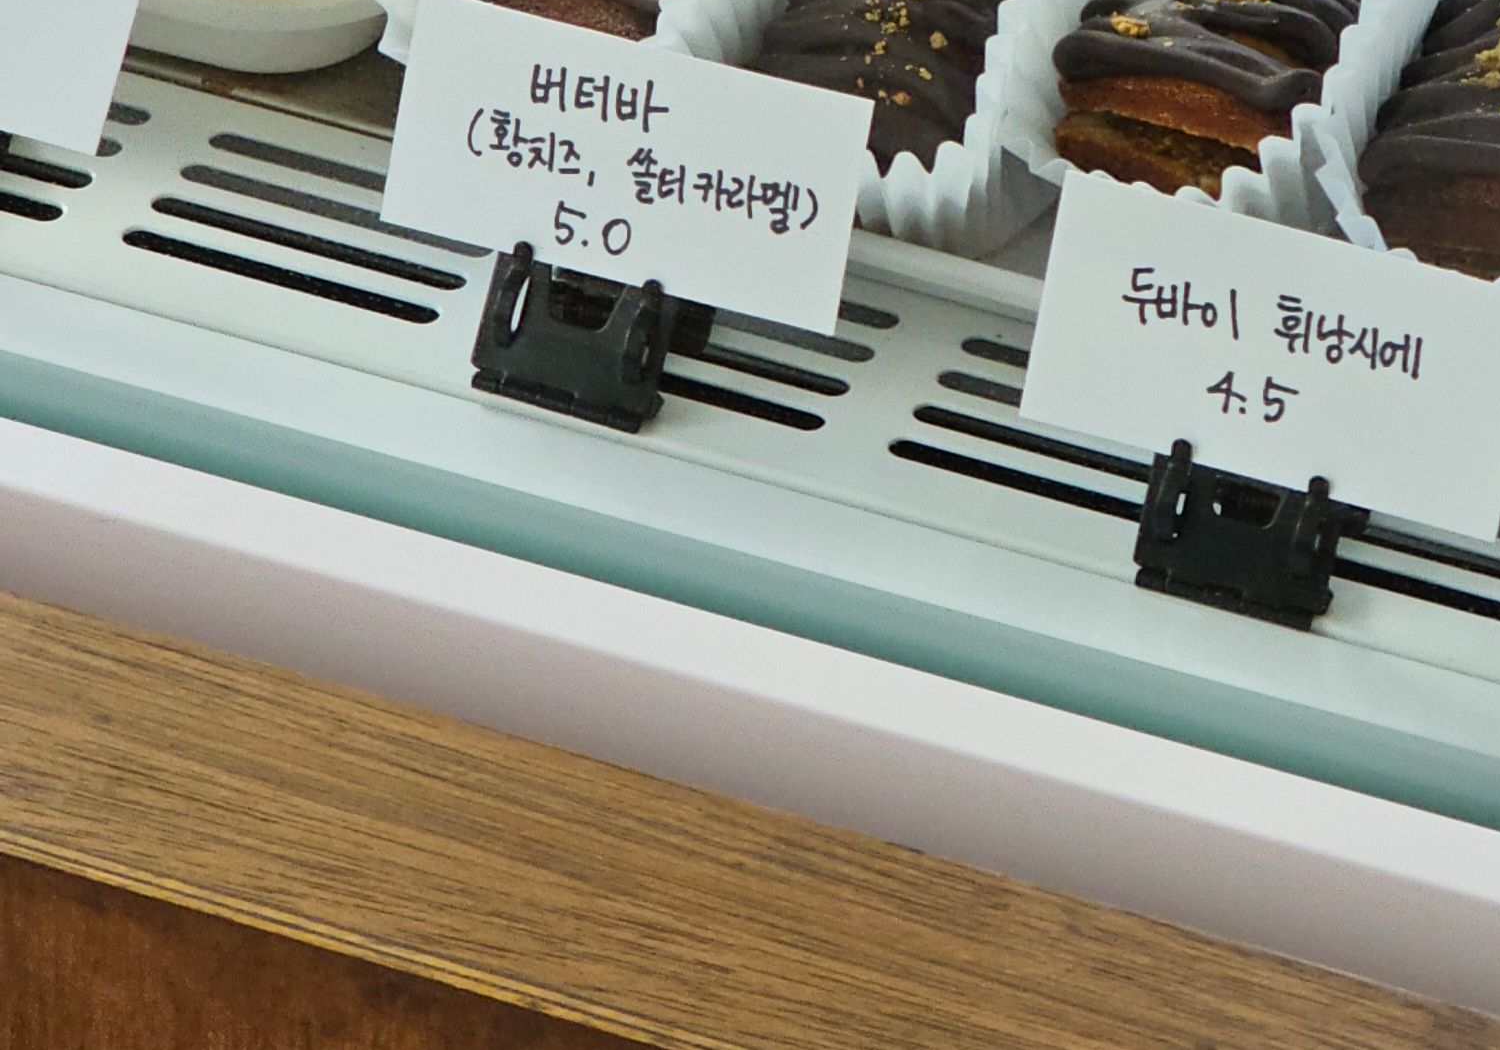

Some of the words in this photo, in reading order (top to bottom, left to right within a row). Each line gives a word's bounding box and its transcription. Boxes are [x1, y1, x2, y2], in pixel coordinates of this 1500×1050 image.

[530, 63, 671, 134] 버터바
[466, 107, 596, 188] (황치즈,
[554, 200, 633, 257] 5.0
[1121, 266, 1240, 341] 두바이
[1273, 293, 1424, 381] 휘낭시에
[1206, 370, 1301, 424] 4.5
